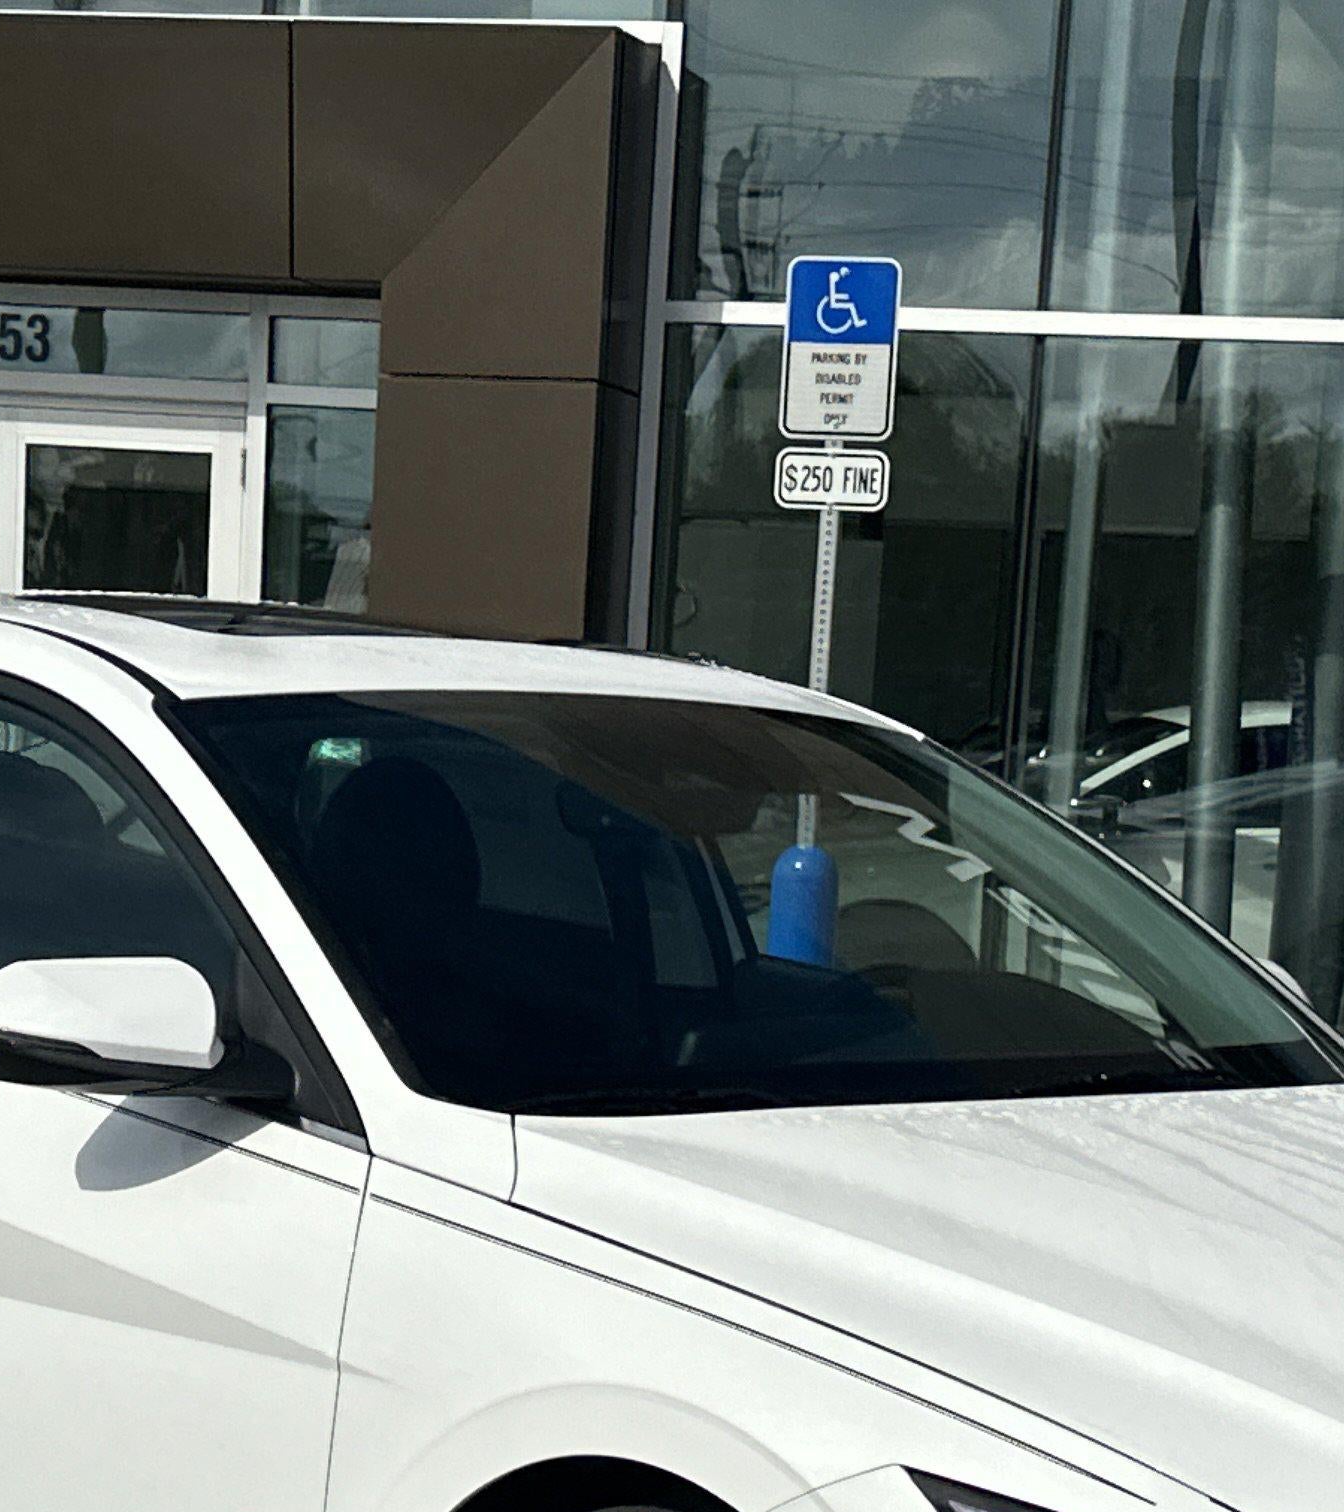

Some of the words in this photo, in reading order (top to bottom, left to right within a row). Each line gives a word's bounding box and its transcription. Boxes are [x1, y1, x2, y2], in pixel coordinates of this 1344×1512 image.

[811, 352, 851, 365] PARKING
[854, 353, 868, 366] BY
[783, 464, 833, 493] $250
[842, 466, 879, 494] FINE
